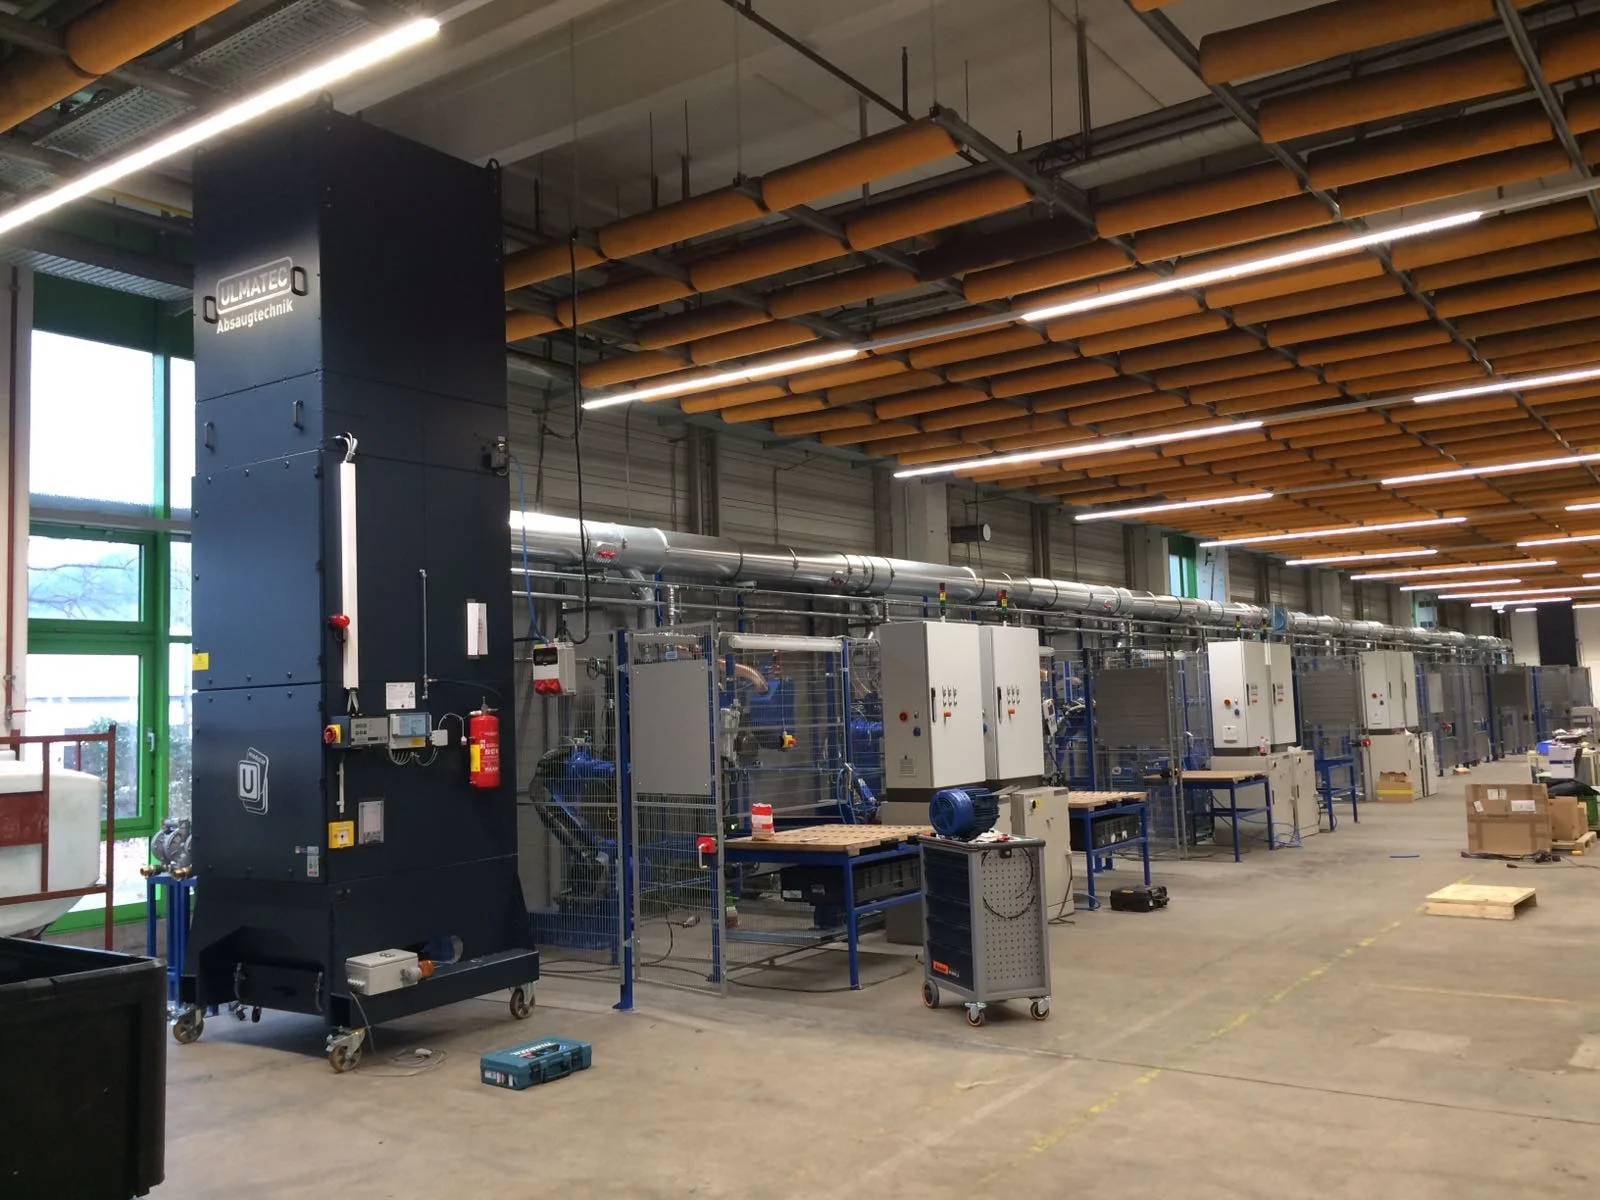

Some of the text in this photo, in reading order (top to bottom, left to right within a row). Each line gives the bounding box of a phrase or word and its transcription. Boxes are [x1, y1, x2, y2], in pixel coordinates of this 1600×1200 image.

[221, 267, 288, 305] ULMATEC
[216, 299, 293, 334] Absaugtechnik
[242, 768, 254, 794] U
